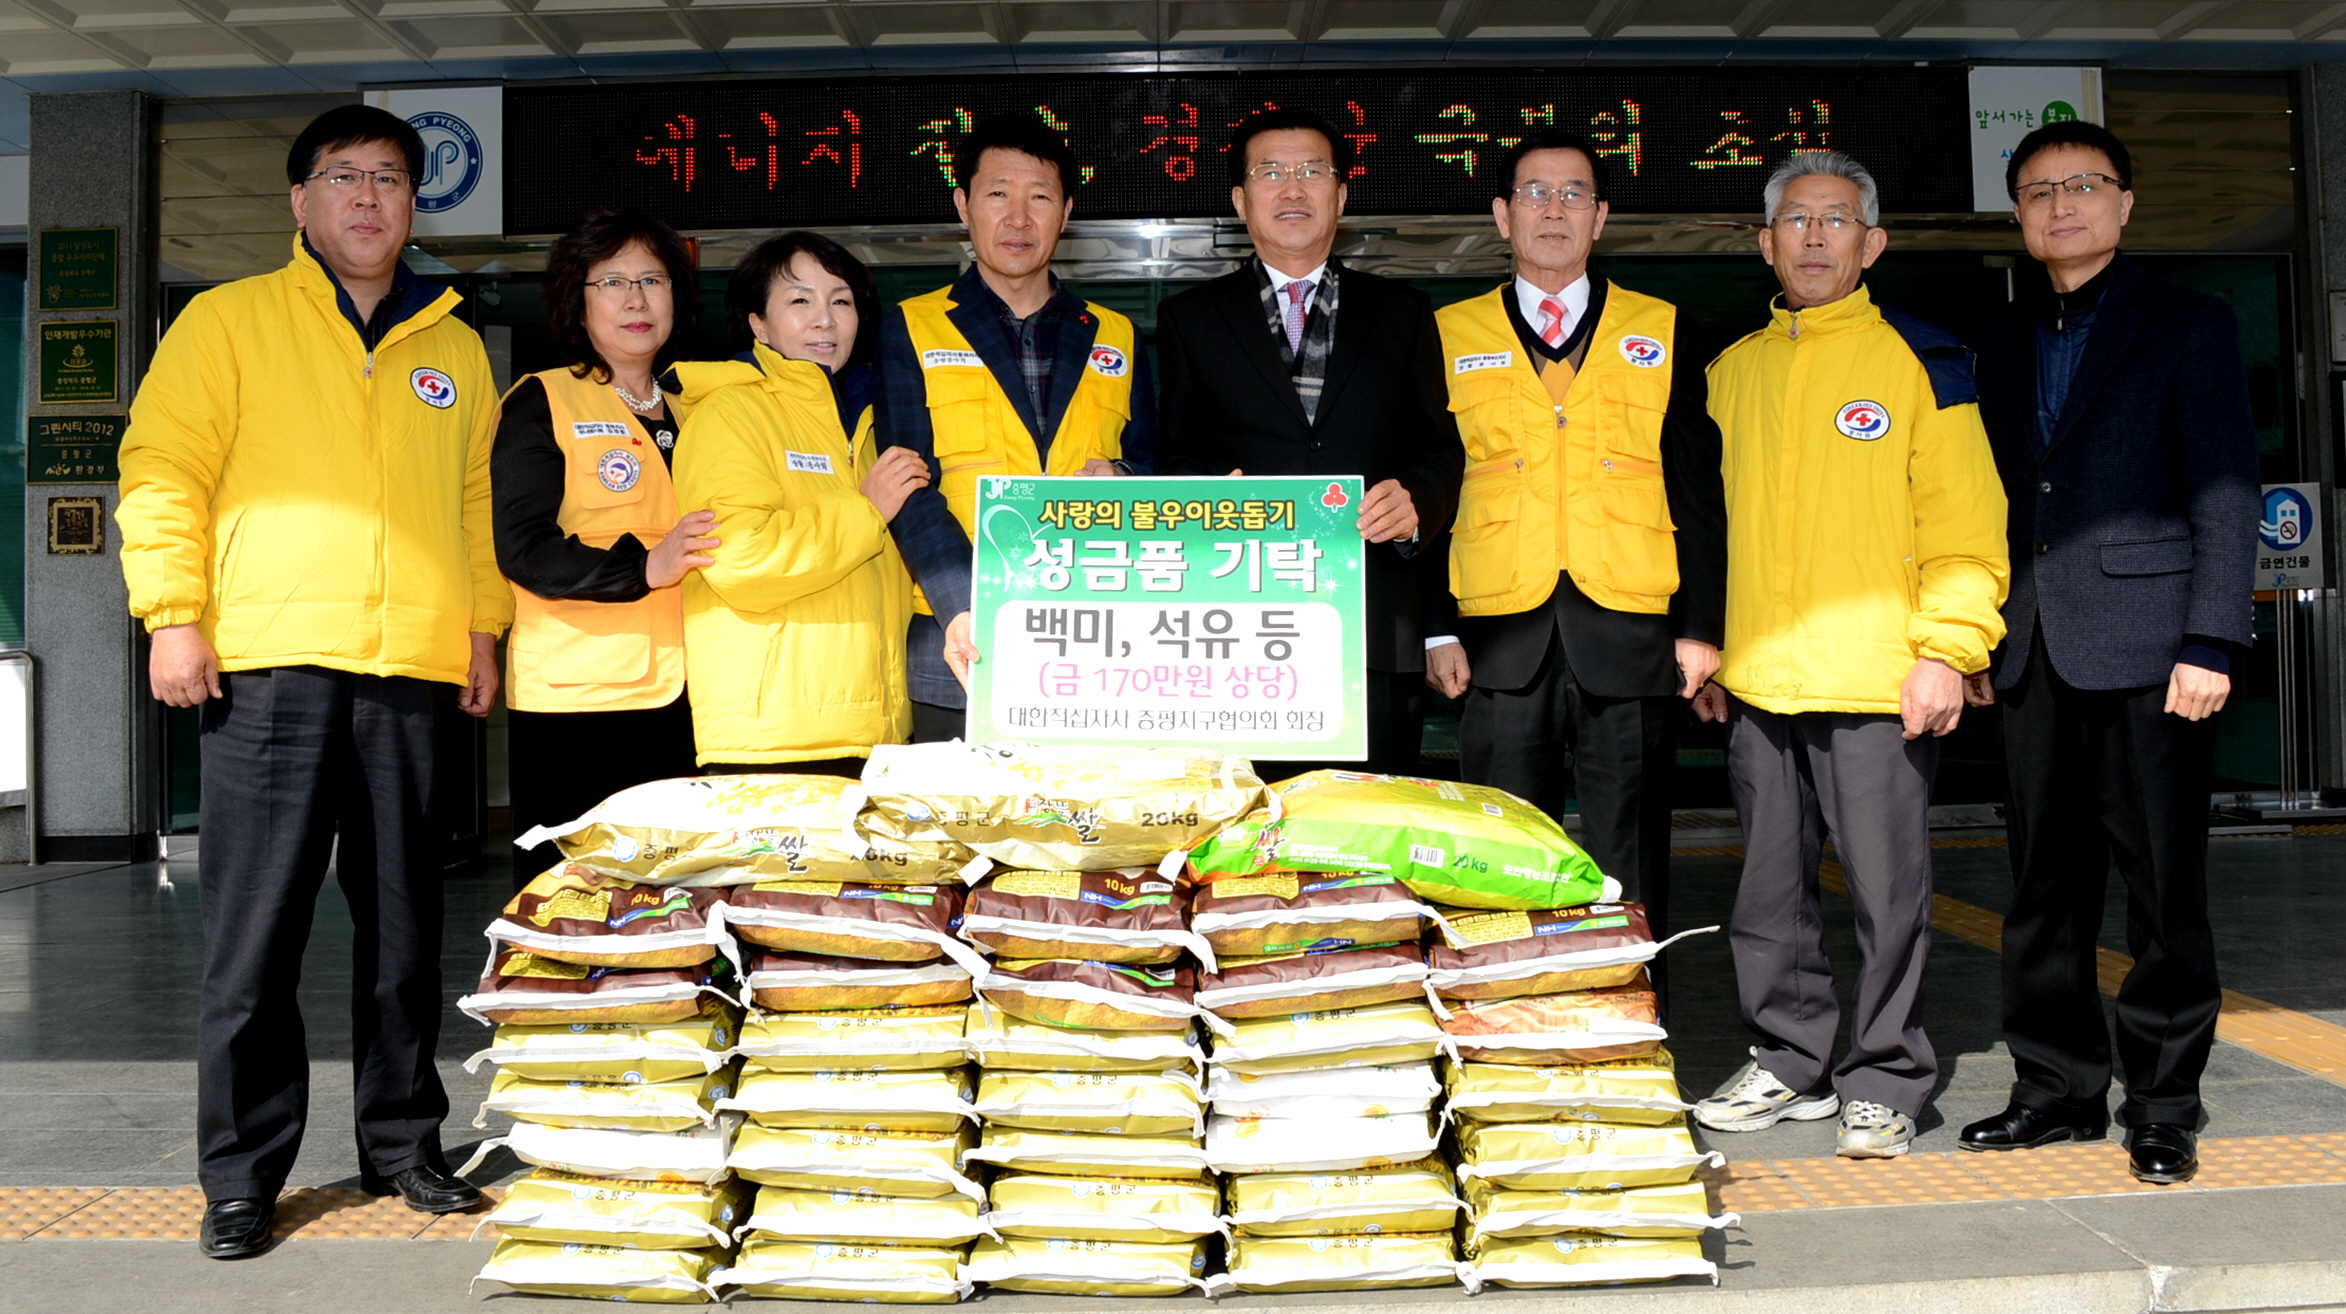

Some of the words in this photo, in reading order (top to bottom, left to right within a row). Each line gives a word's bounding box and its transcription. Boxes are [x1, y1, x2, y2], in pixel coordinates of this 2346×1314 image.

[1975, 109, 2034, 129] 앞서가는
[433, 116, 472, 143] PYEONG
[44, 329, 112, 341] 인재개발우수기관
[40, 421, 83, 435] 그린시티
[85, 421, 115, 436] 2012
[1012, 483, 1035, 496] 증평군
[1039, 500, 1122, 530] 사랑의
[1130, 500, 1295, 531] 불우이웃돕기
[1023, 538, 1189, 592] 성금품
[1210, 538, 1324, 592] 기탁
[2259, 555, 2311, 570] 금연건물
[1025, 607, 1132, 658] 백미,
[1149, 609, 1240, 660] 석유
[1255, 609, 1300, 661] 등
[1038, 661, 1082, 699] (금
[1092, 664, 1213, 700] 170만원
[1225, 664, 1299, 702] 상당)
[1008, 706, 1130, 730] 대한적십자사
[1137, 708, 1278, 732] 증평지구협의회
[1285, 711, 1325, 733] 회장
[1141, 811, 1199, 827] 20kg
[1453, 855, 1469, 868] 20
[1471, 857, 1489, 874] kg
[1303, 883, 1322, 891] NH
[1083, 892, 1103, 902] NH
[610, 917, 626, 927] NH
[1537, 924, 1557, 933] NH
